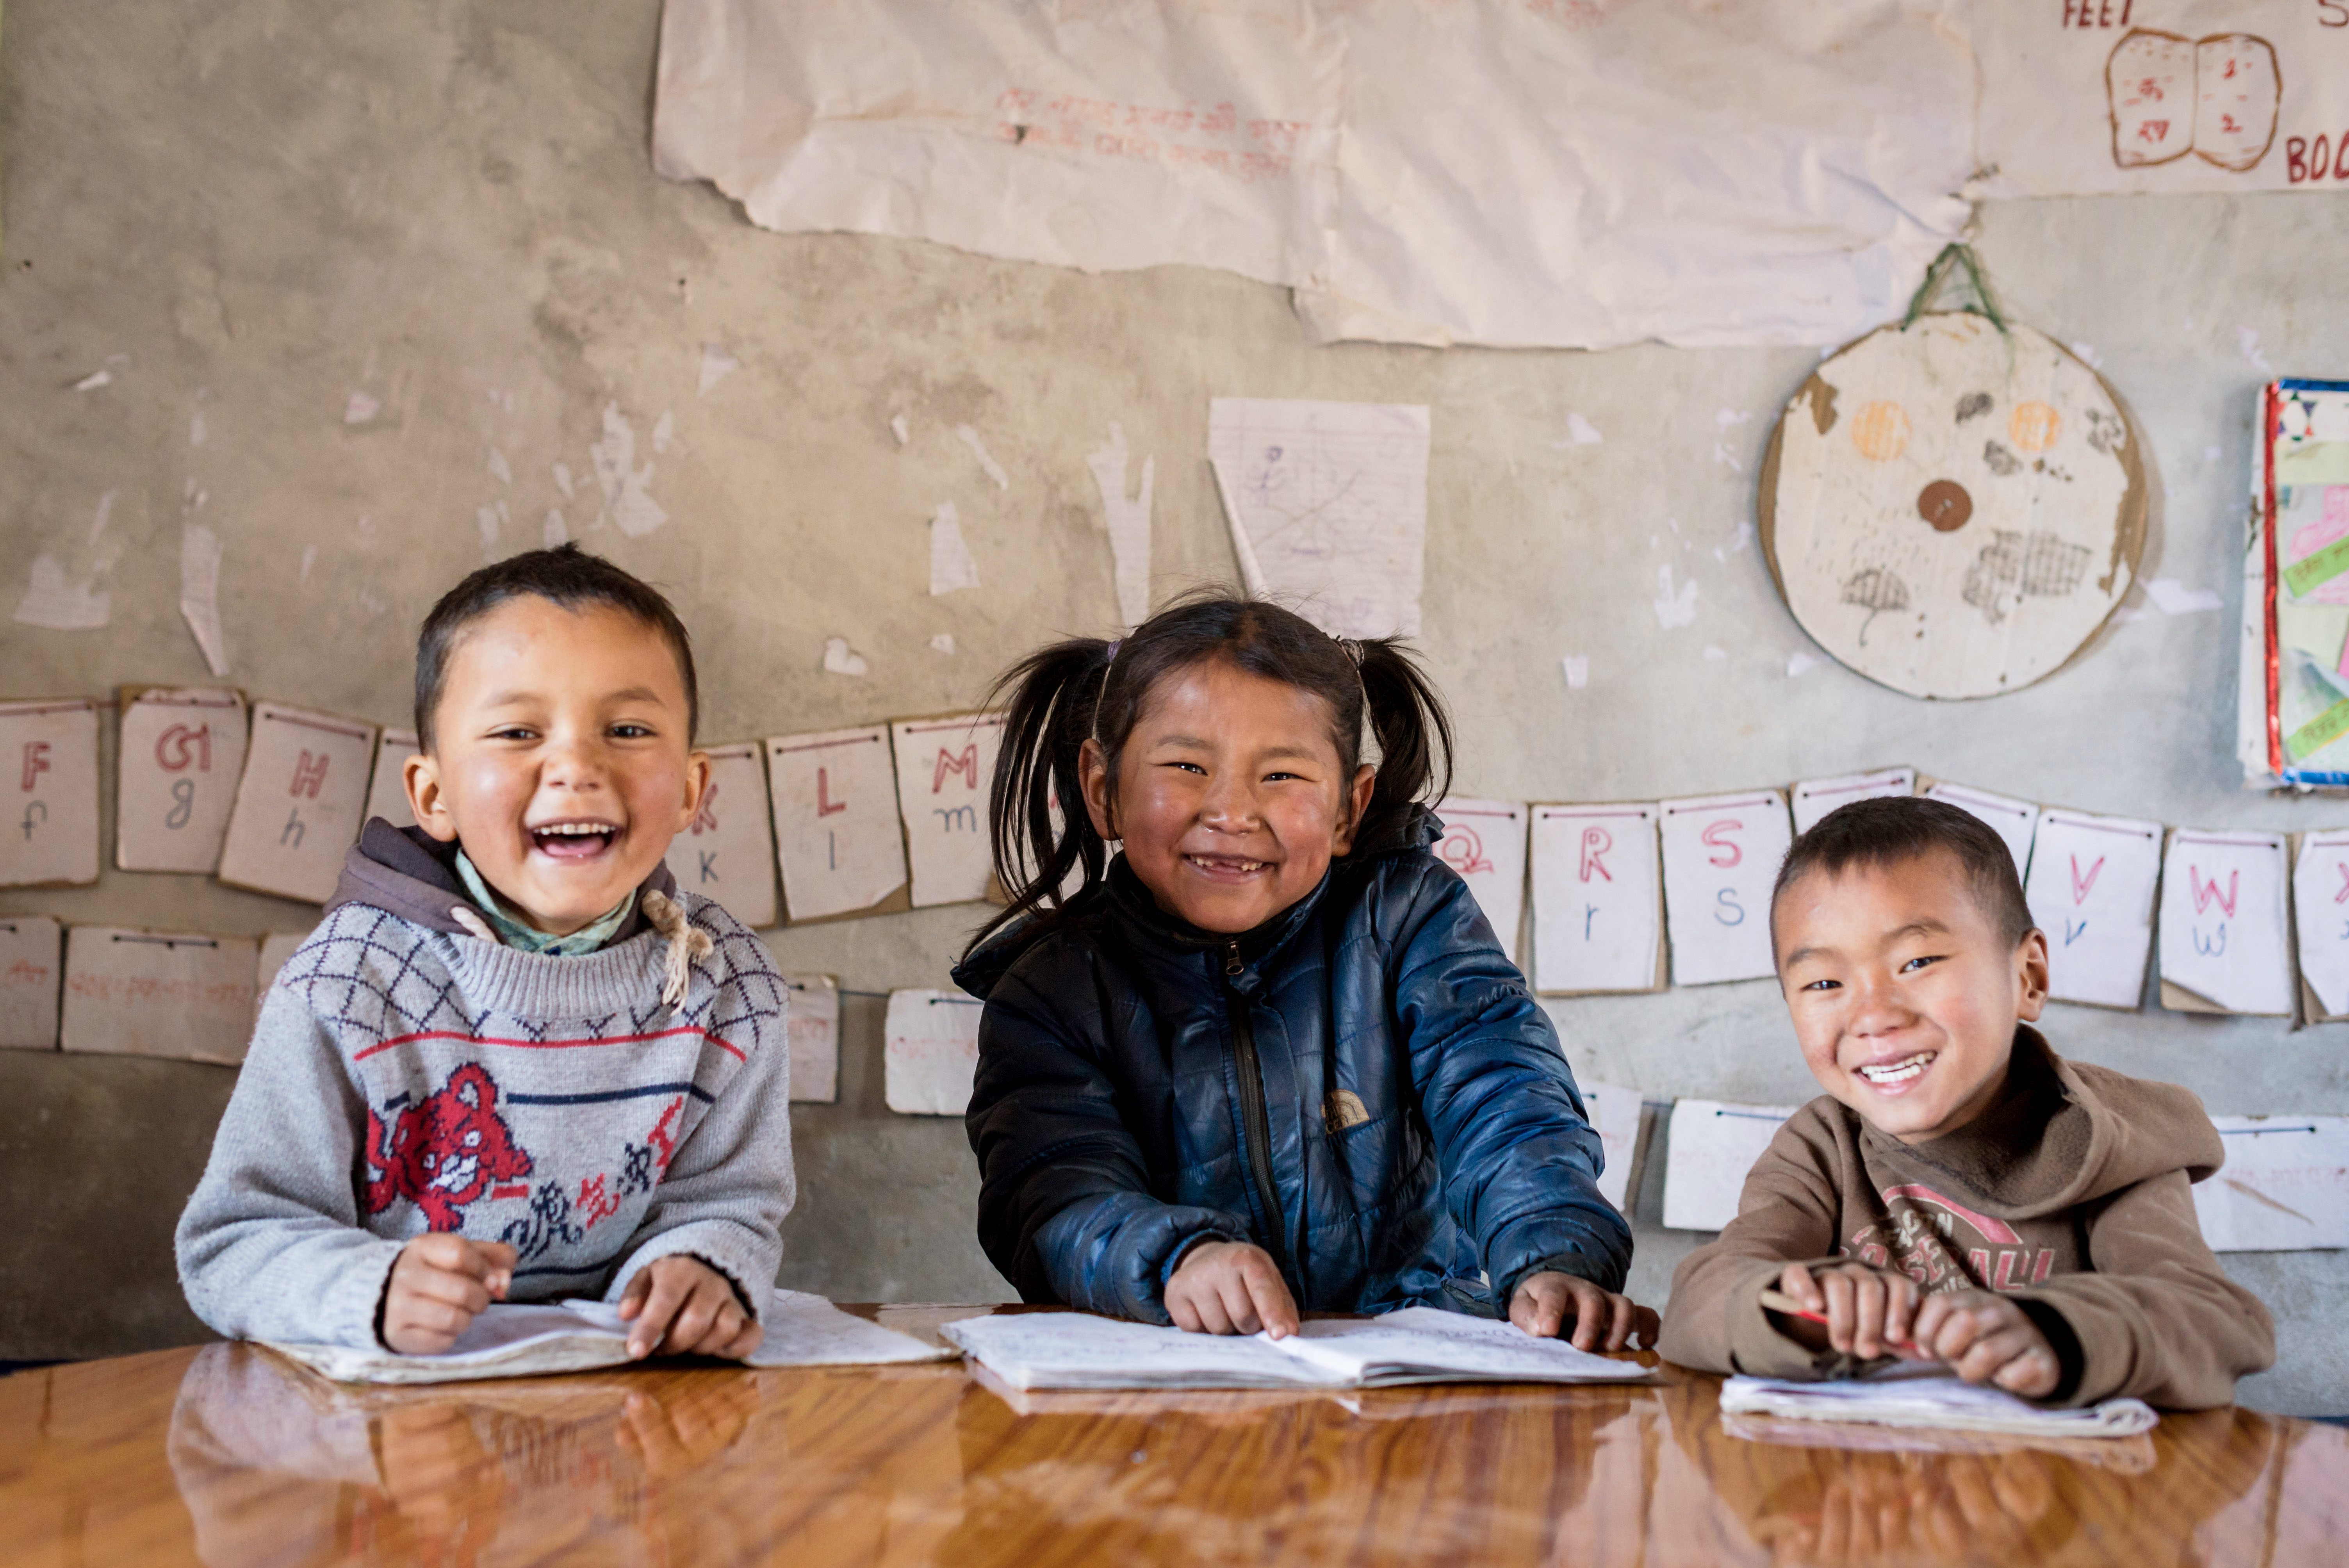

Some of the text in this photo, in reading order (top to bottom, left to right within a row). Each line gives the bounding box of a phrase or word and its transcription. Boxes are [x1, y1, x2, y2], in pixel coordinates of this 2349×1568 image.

[21, 741, 51, 792] F
[156, 723, 211, 773] G
[932, 743, 978, 794] M
[289, 749, 330, 799] H
[817, 766, 846, 818] L
[21, 800, 48, 841] f
[165, 778, 195, 830] g
[280, 808, 307, 849] h
[934, 805, 977, 833] m
[1432, 823, 1495, 875] Q
[1579, 826, 1613, 883] R
[1701, 819, 1743, 868] S
[2071, 853, 2105, 906] V
[2190, 864, 2240, 919] W
[1584, 902, 1600, 941] r
